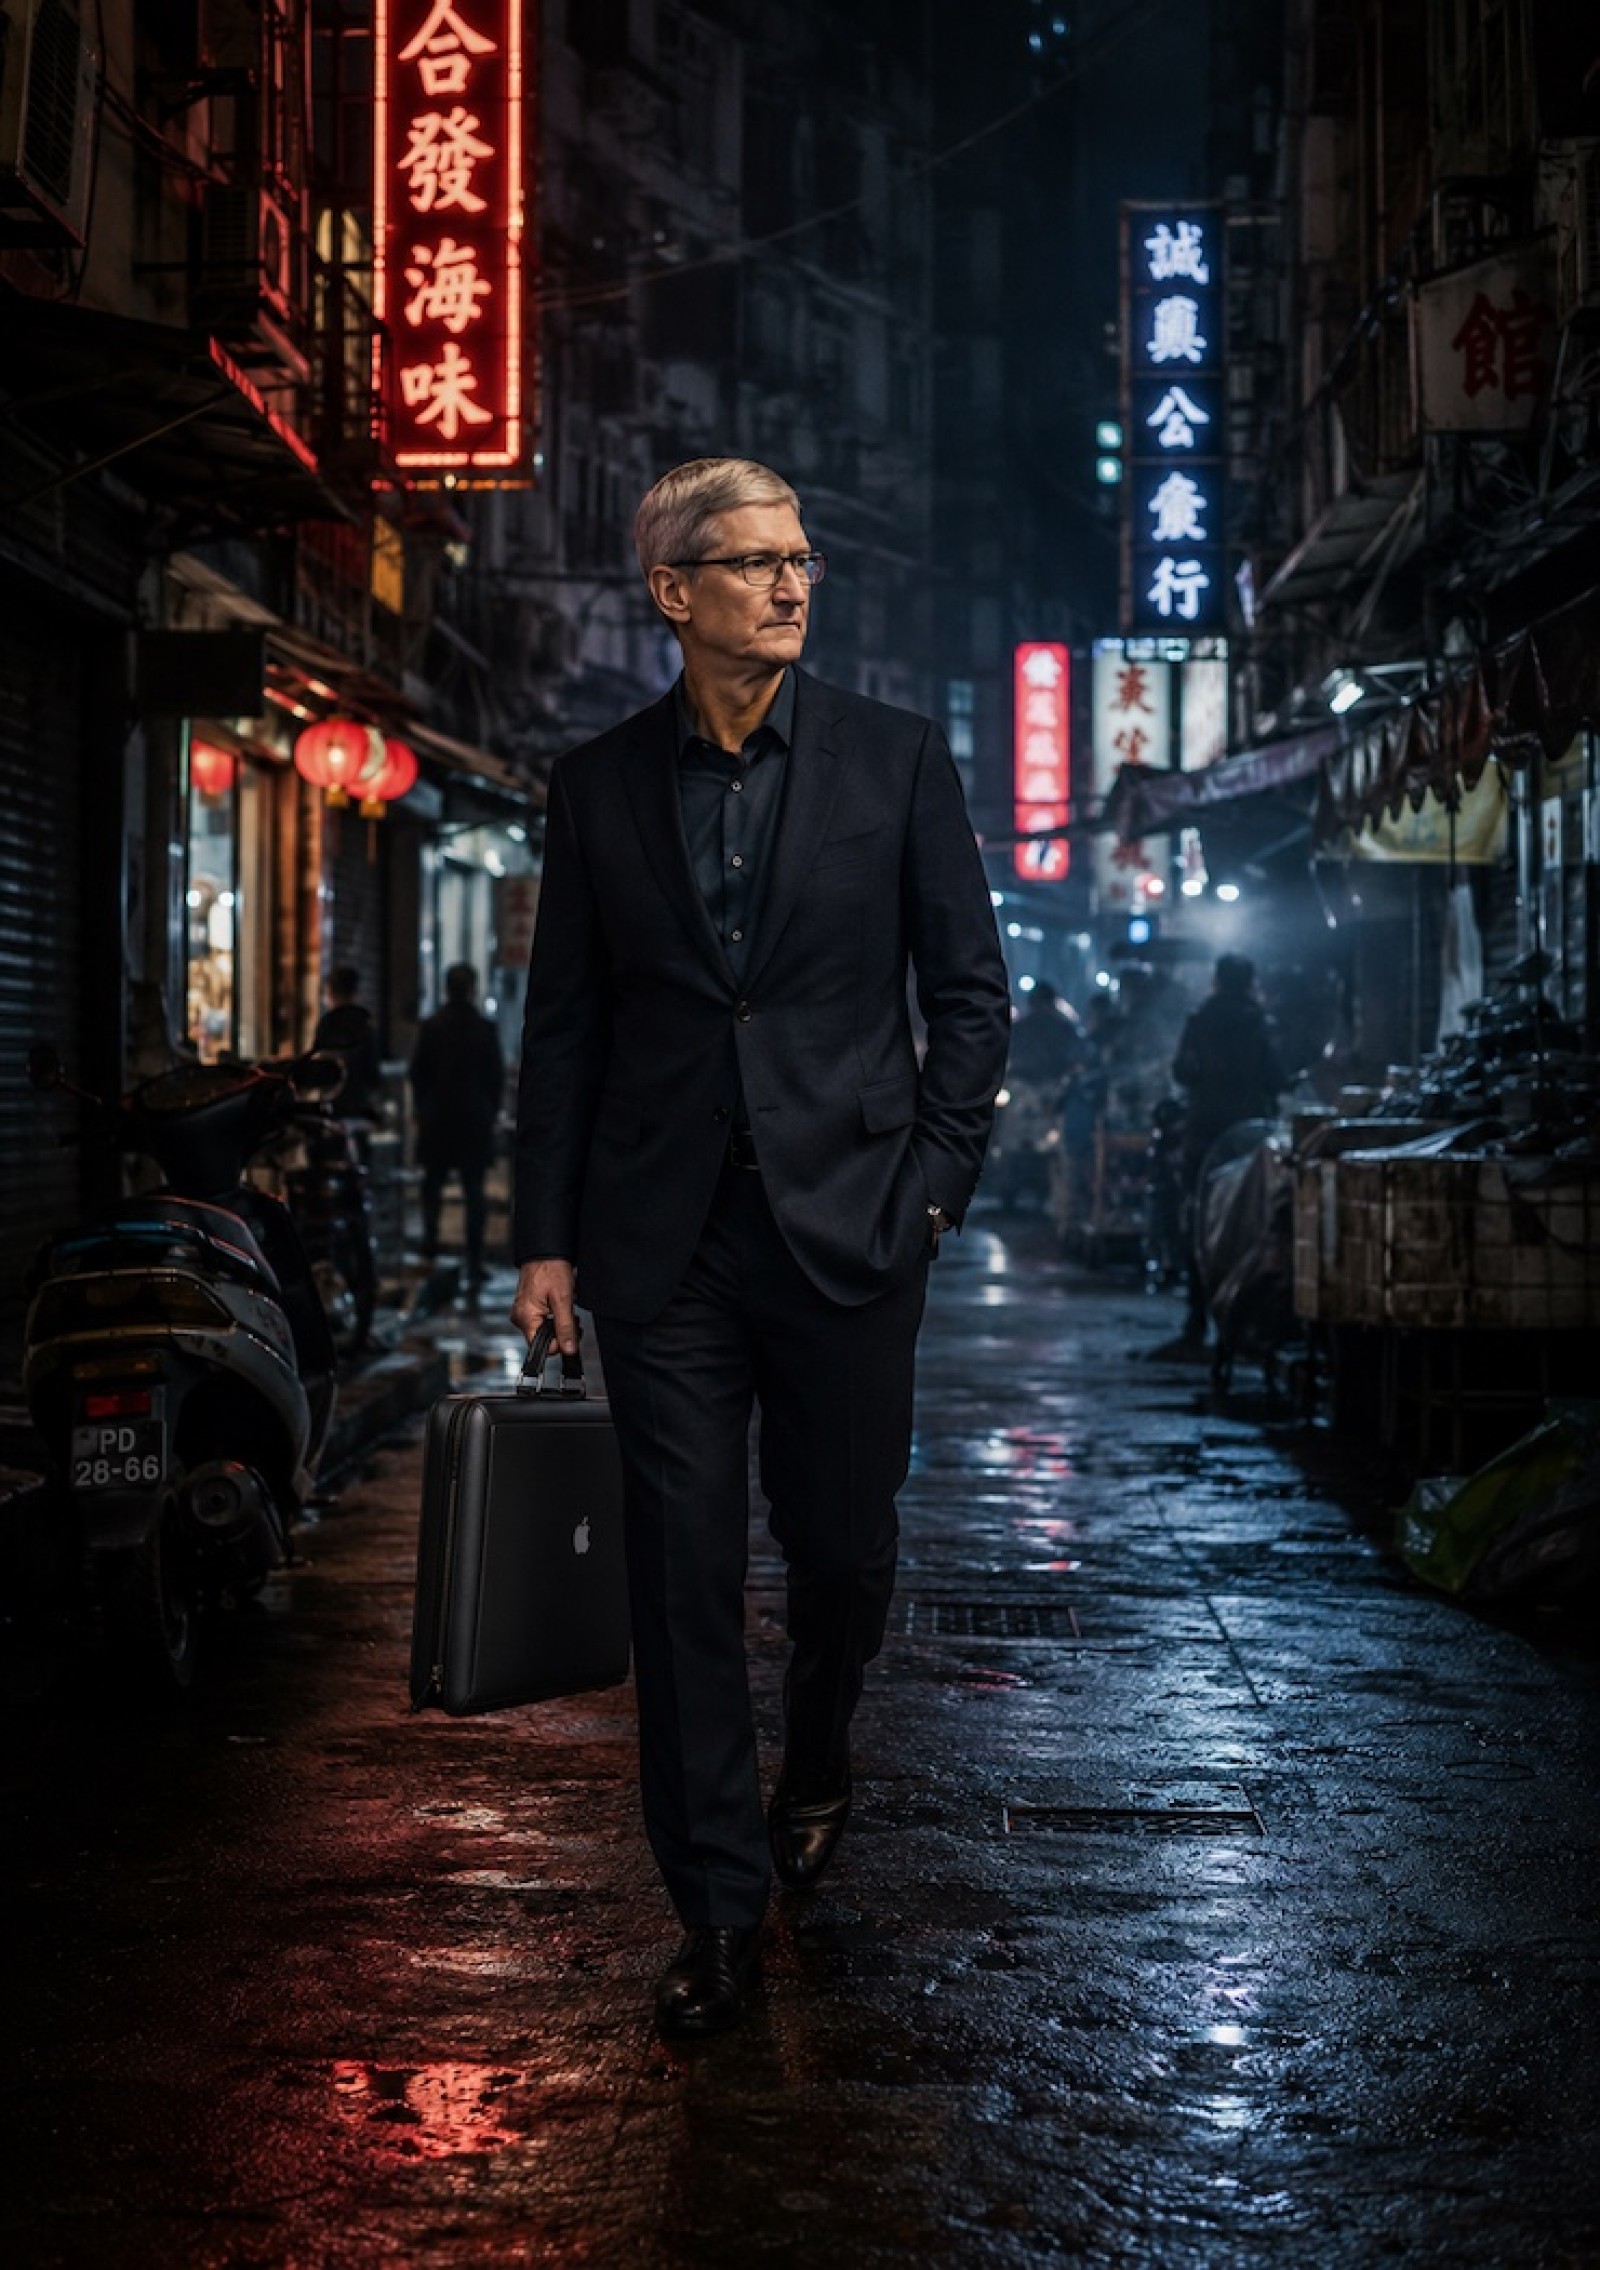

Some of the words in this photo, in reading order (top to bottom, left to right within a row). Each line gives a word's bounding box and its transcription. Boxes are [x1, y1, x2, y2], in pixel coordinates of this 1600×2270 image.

[397, 0, 498, 441] 合發海味
[1452, 289, 1554, 401] 館
[74, 1454, 160, 1486] 28-66
[100, 1427, 136, 1454] PD
